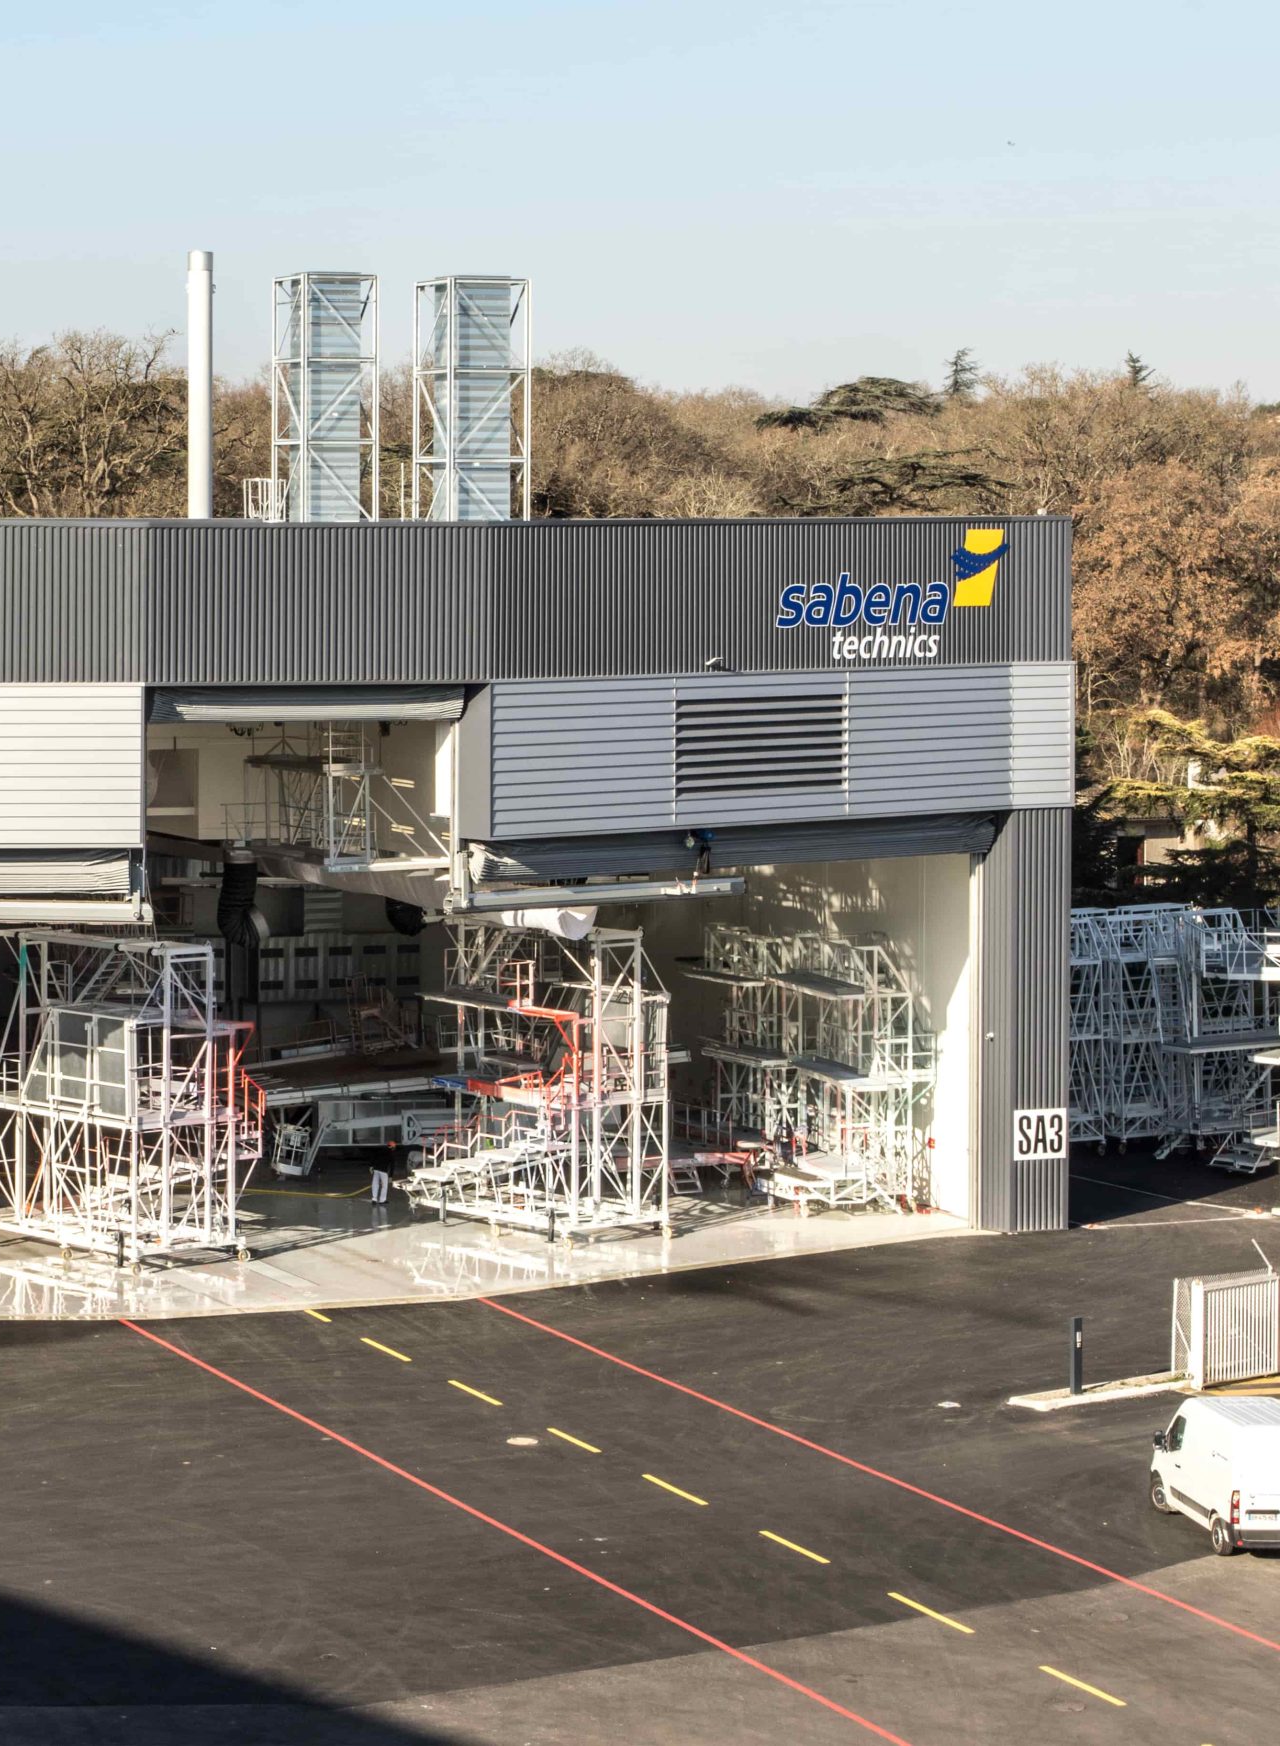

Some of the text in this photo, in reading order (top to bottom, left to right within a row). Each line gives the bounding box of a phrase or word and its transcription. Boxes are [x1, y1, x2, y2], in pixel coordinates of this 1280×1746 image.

[777, 573, 949, 628] sabena
[832, 627, 940, 660] technics
[1018, 1114, 1063, 1155] SA3
